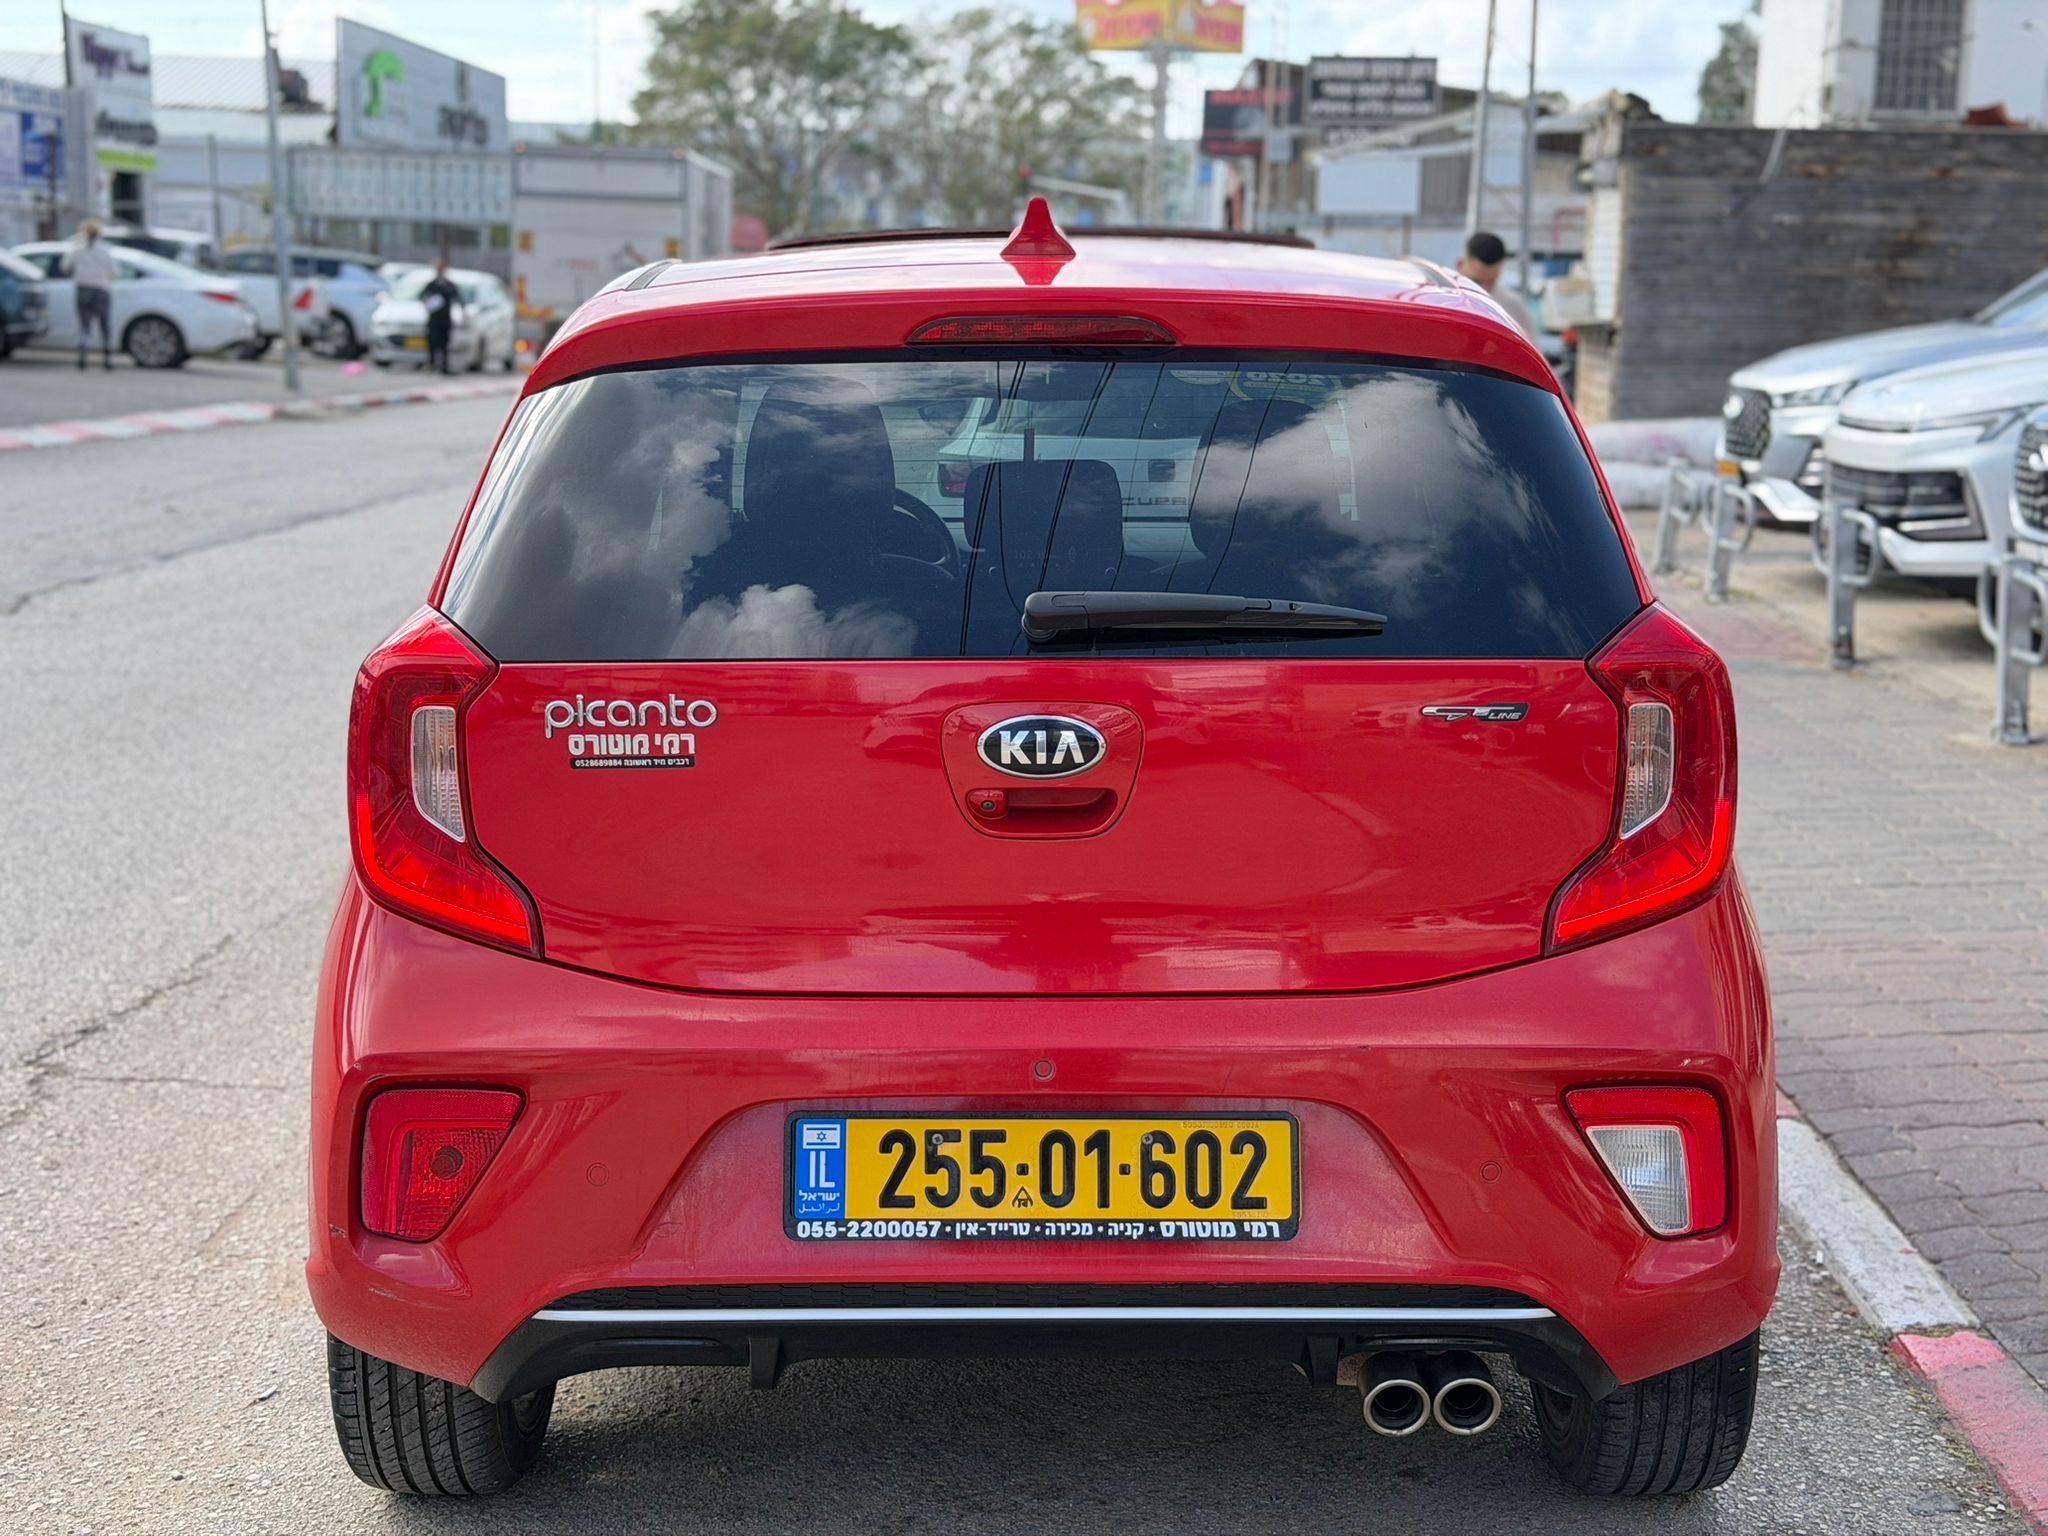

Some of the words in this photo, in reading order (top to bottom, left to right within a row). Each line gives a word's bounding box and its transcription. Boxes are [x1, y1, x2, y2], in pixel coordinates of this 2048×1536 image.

[1121, 496, 1187, 505] CUPR
[544, 693, 718, 739] picanto
[1488, 712, 1522, 720] LINE
[568, 733, 650, 756] מוטורס
[654, 733, 696, 755] רמי
[999, 730, 1085, 765] KIA
[809, 1150, 836, 1188] IL
[798, 1190, 840, 1201] ישראל
[797, 1220, 942, 1238] 055-2200057
[955, 1222, 1031, 1239] טרייד-אין
[1044, 1221, 1093, 1236] מכירה
[1107, 1221, 1144, 1239] קניה
[1159, 1220, 1237, 1238] מוטורס
[1243, 1220, 1280, 1238] רמי
